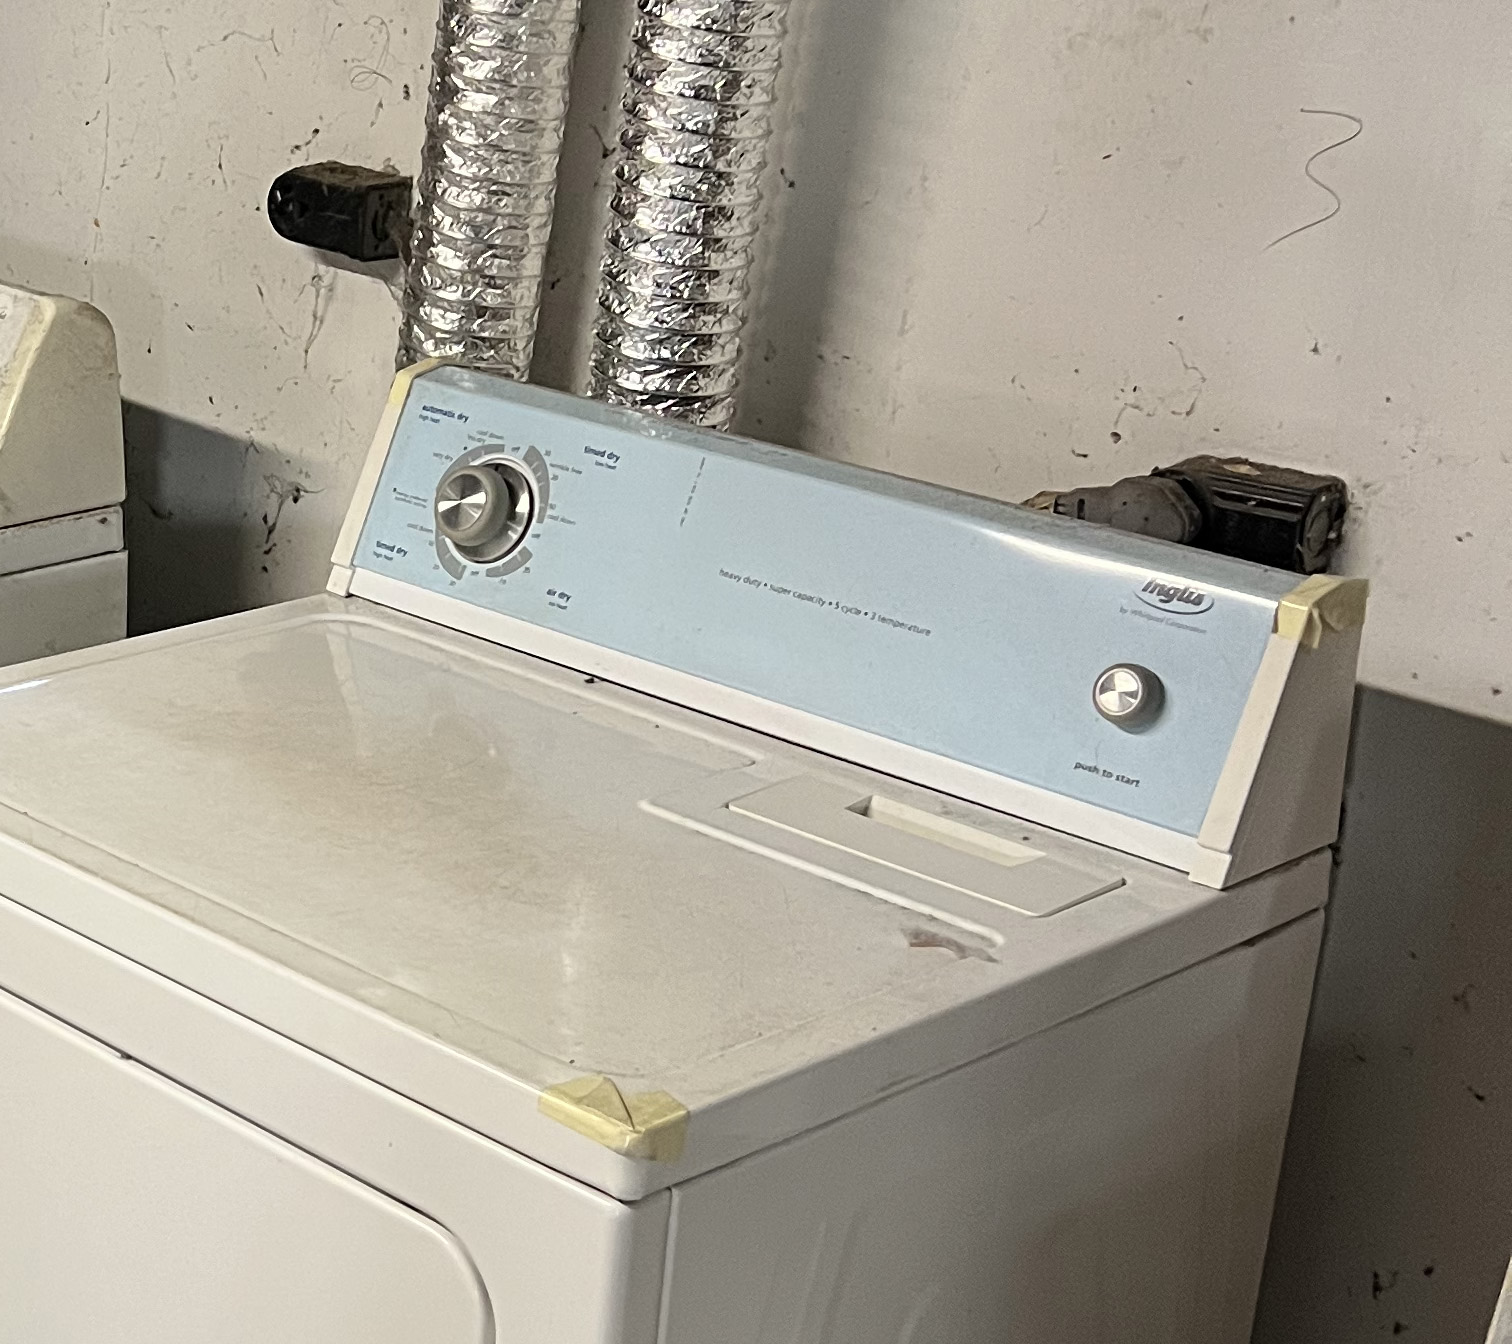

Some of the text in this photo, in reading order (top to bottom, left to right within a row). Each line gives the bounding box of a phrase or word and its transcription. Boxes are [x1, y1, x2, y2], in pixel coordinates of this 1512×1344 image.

[456, 412, 469, 423] dry
[606, 451, 620, 464] dry
[558, 591, 572, 603] dry
[719, 568, 742, 583] heavy
[743, 576, 762, 589] duty
[769, 583, 792, 596] super
[792, 591, 826, 608] capacity
[841, 605, 862, 616] cycle
[870, 611, 877, 621] 3
[877, 614, 932, 637] temperature
[1073, 762, 1141, 788] push to start
